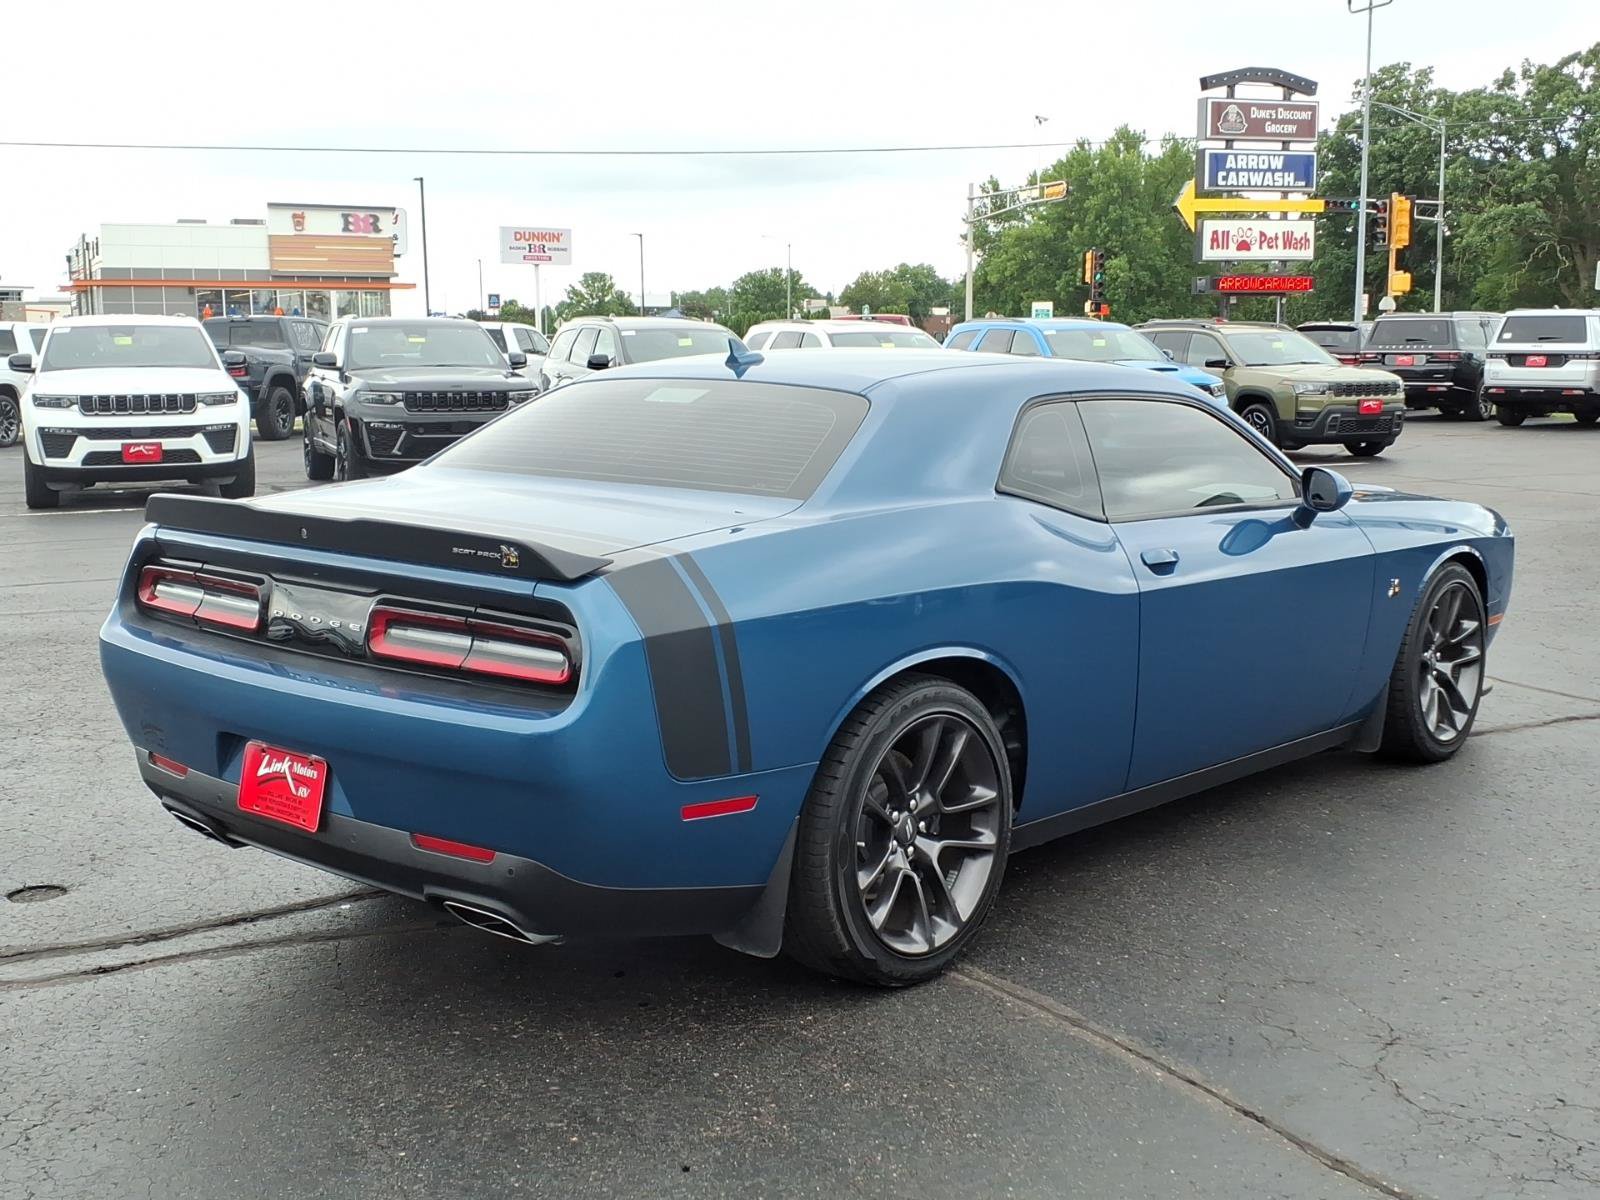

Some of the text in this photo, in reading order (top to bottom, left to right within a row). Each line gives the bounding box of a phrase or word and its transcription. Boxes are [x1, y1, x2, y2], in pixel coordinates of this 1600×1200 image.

[1250, 107, 1312, 120] DUKE'S DISCOUNT
[1265, 121, 1297, 133] GROCERY
[1225, 155, 1284, 169] ARROW
[1210, 229, 1311, 251] All Pet Wash
[452, 547, 501, 559] SCAT PACK
[273, 609, 361, 632] DODGE
[257, 754, 318, 796] Link Motors
[297, 786, 311, 798] RV
